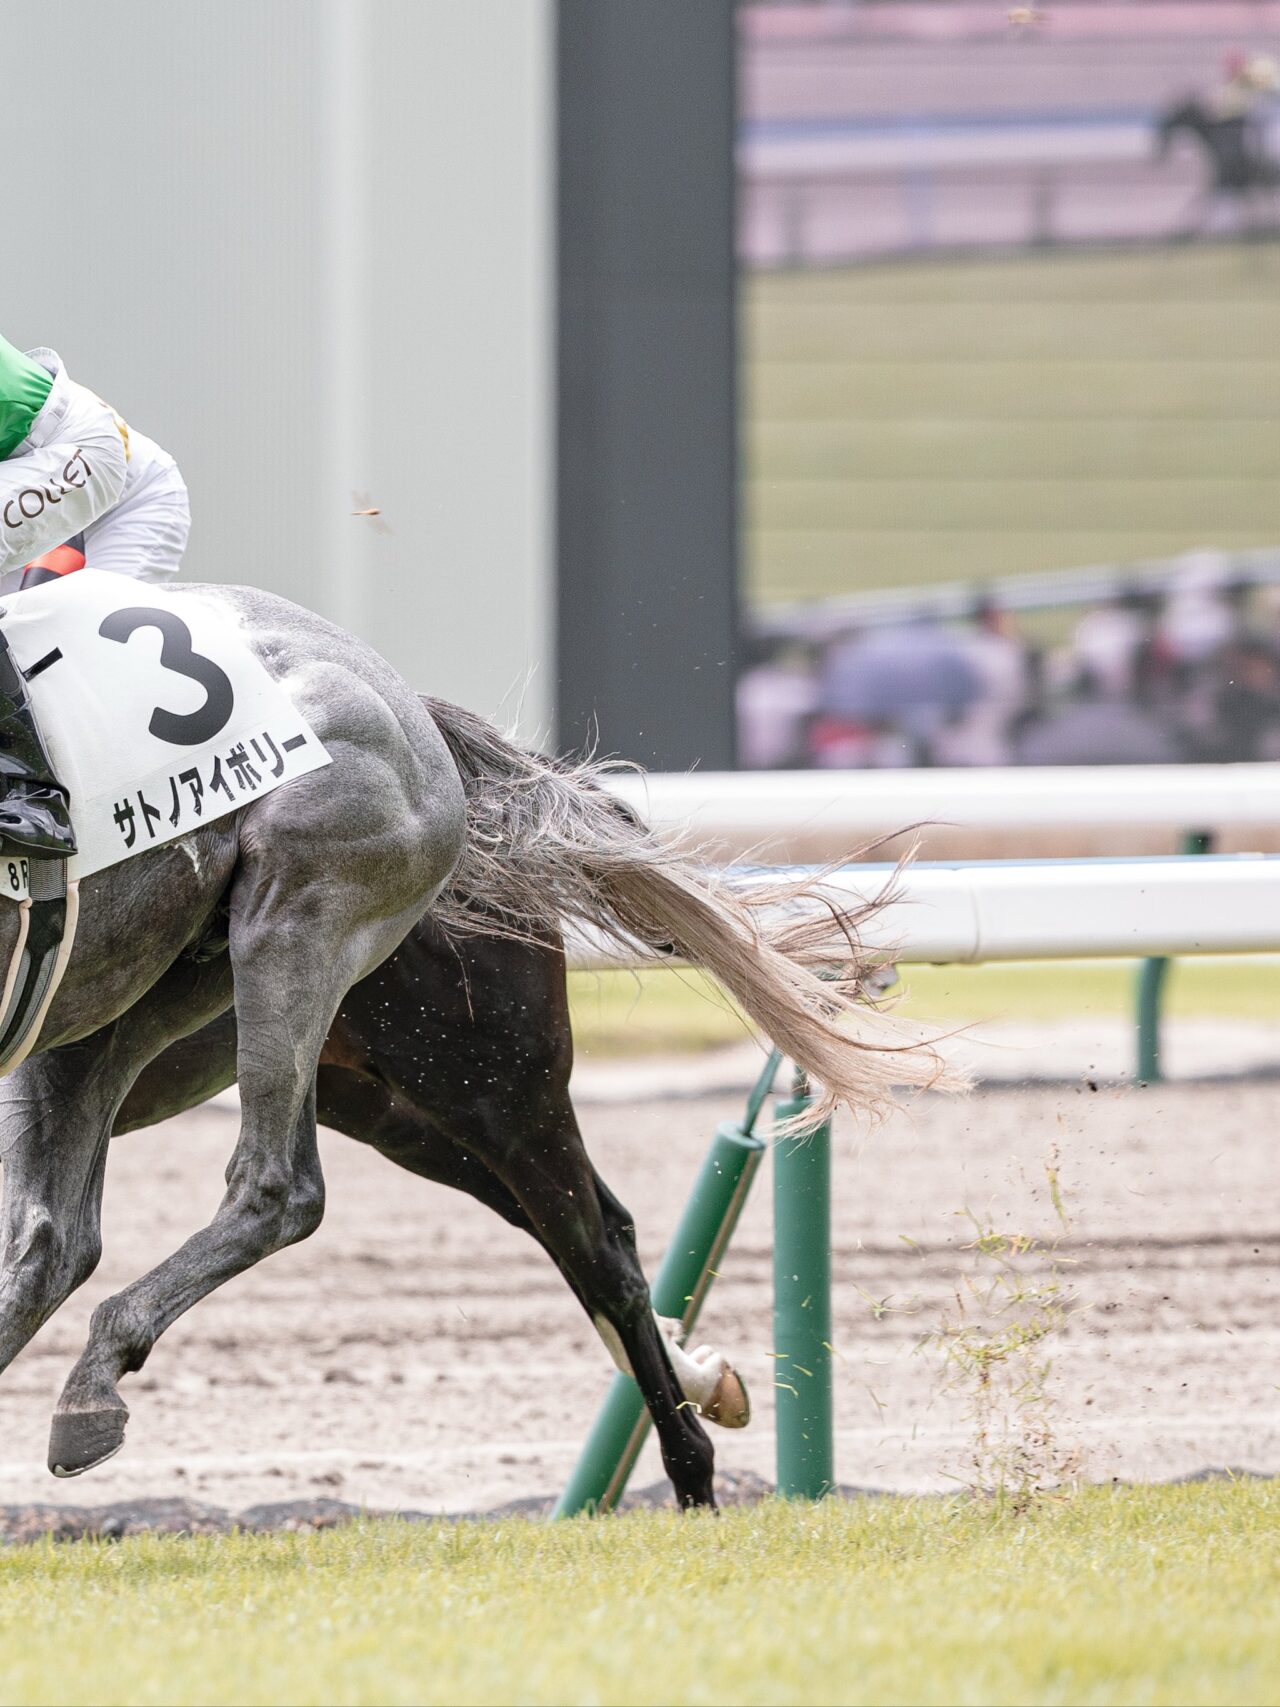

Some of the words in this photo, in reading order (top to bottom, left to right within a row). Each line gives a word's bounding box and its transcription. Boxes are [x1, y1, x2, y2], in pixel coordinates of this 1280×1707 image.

[3, 448, 92, 529] COLLET
[98, 606, 234, 746] 3
[113, 732, 308, 849] サトノアイボリー
